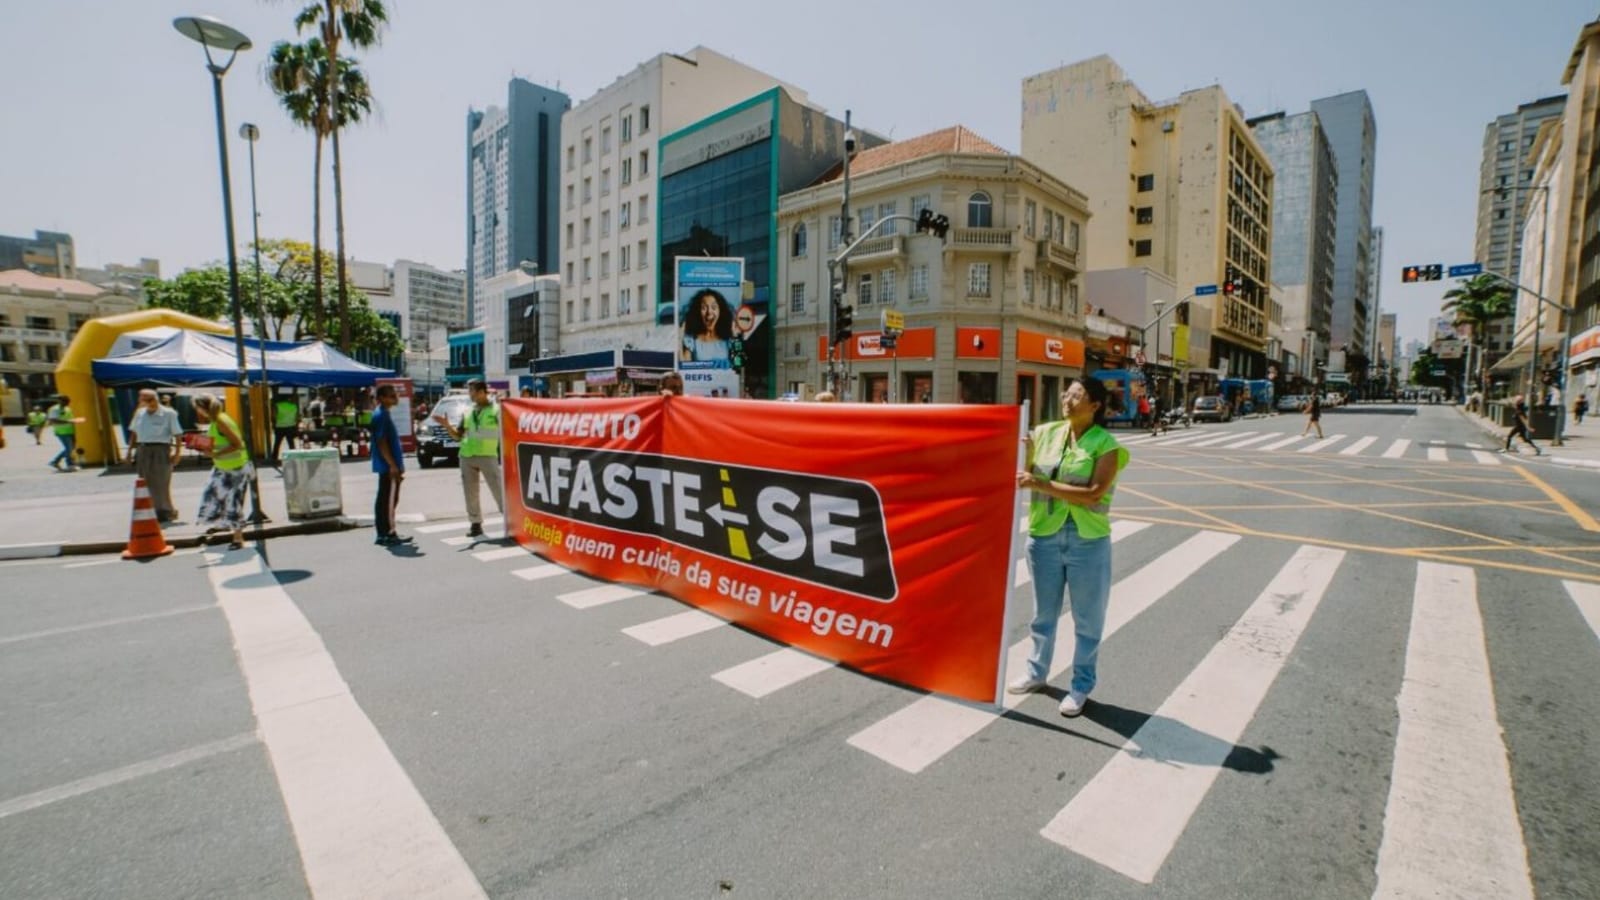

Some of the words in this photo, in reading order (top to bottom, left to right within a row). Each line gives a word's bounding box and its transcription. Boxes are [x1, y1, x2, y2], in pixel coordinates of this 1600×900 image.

[685, 373, 712, 381] REFIS
[518, 411, 641, 441] MOVIMENTO
[523, 516, 563, 546] Proteja
[565, 533, 616, 555] quem
[621, 546, 680, 577] cuida
[685, 561, 712, 589] da
[716, 575, 762, 606] sua
[770, 591, 894, 648] viagem
